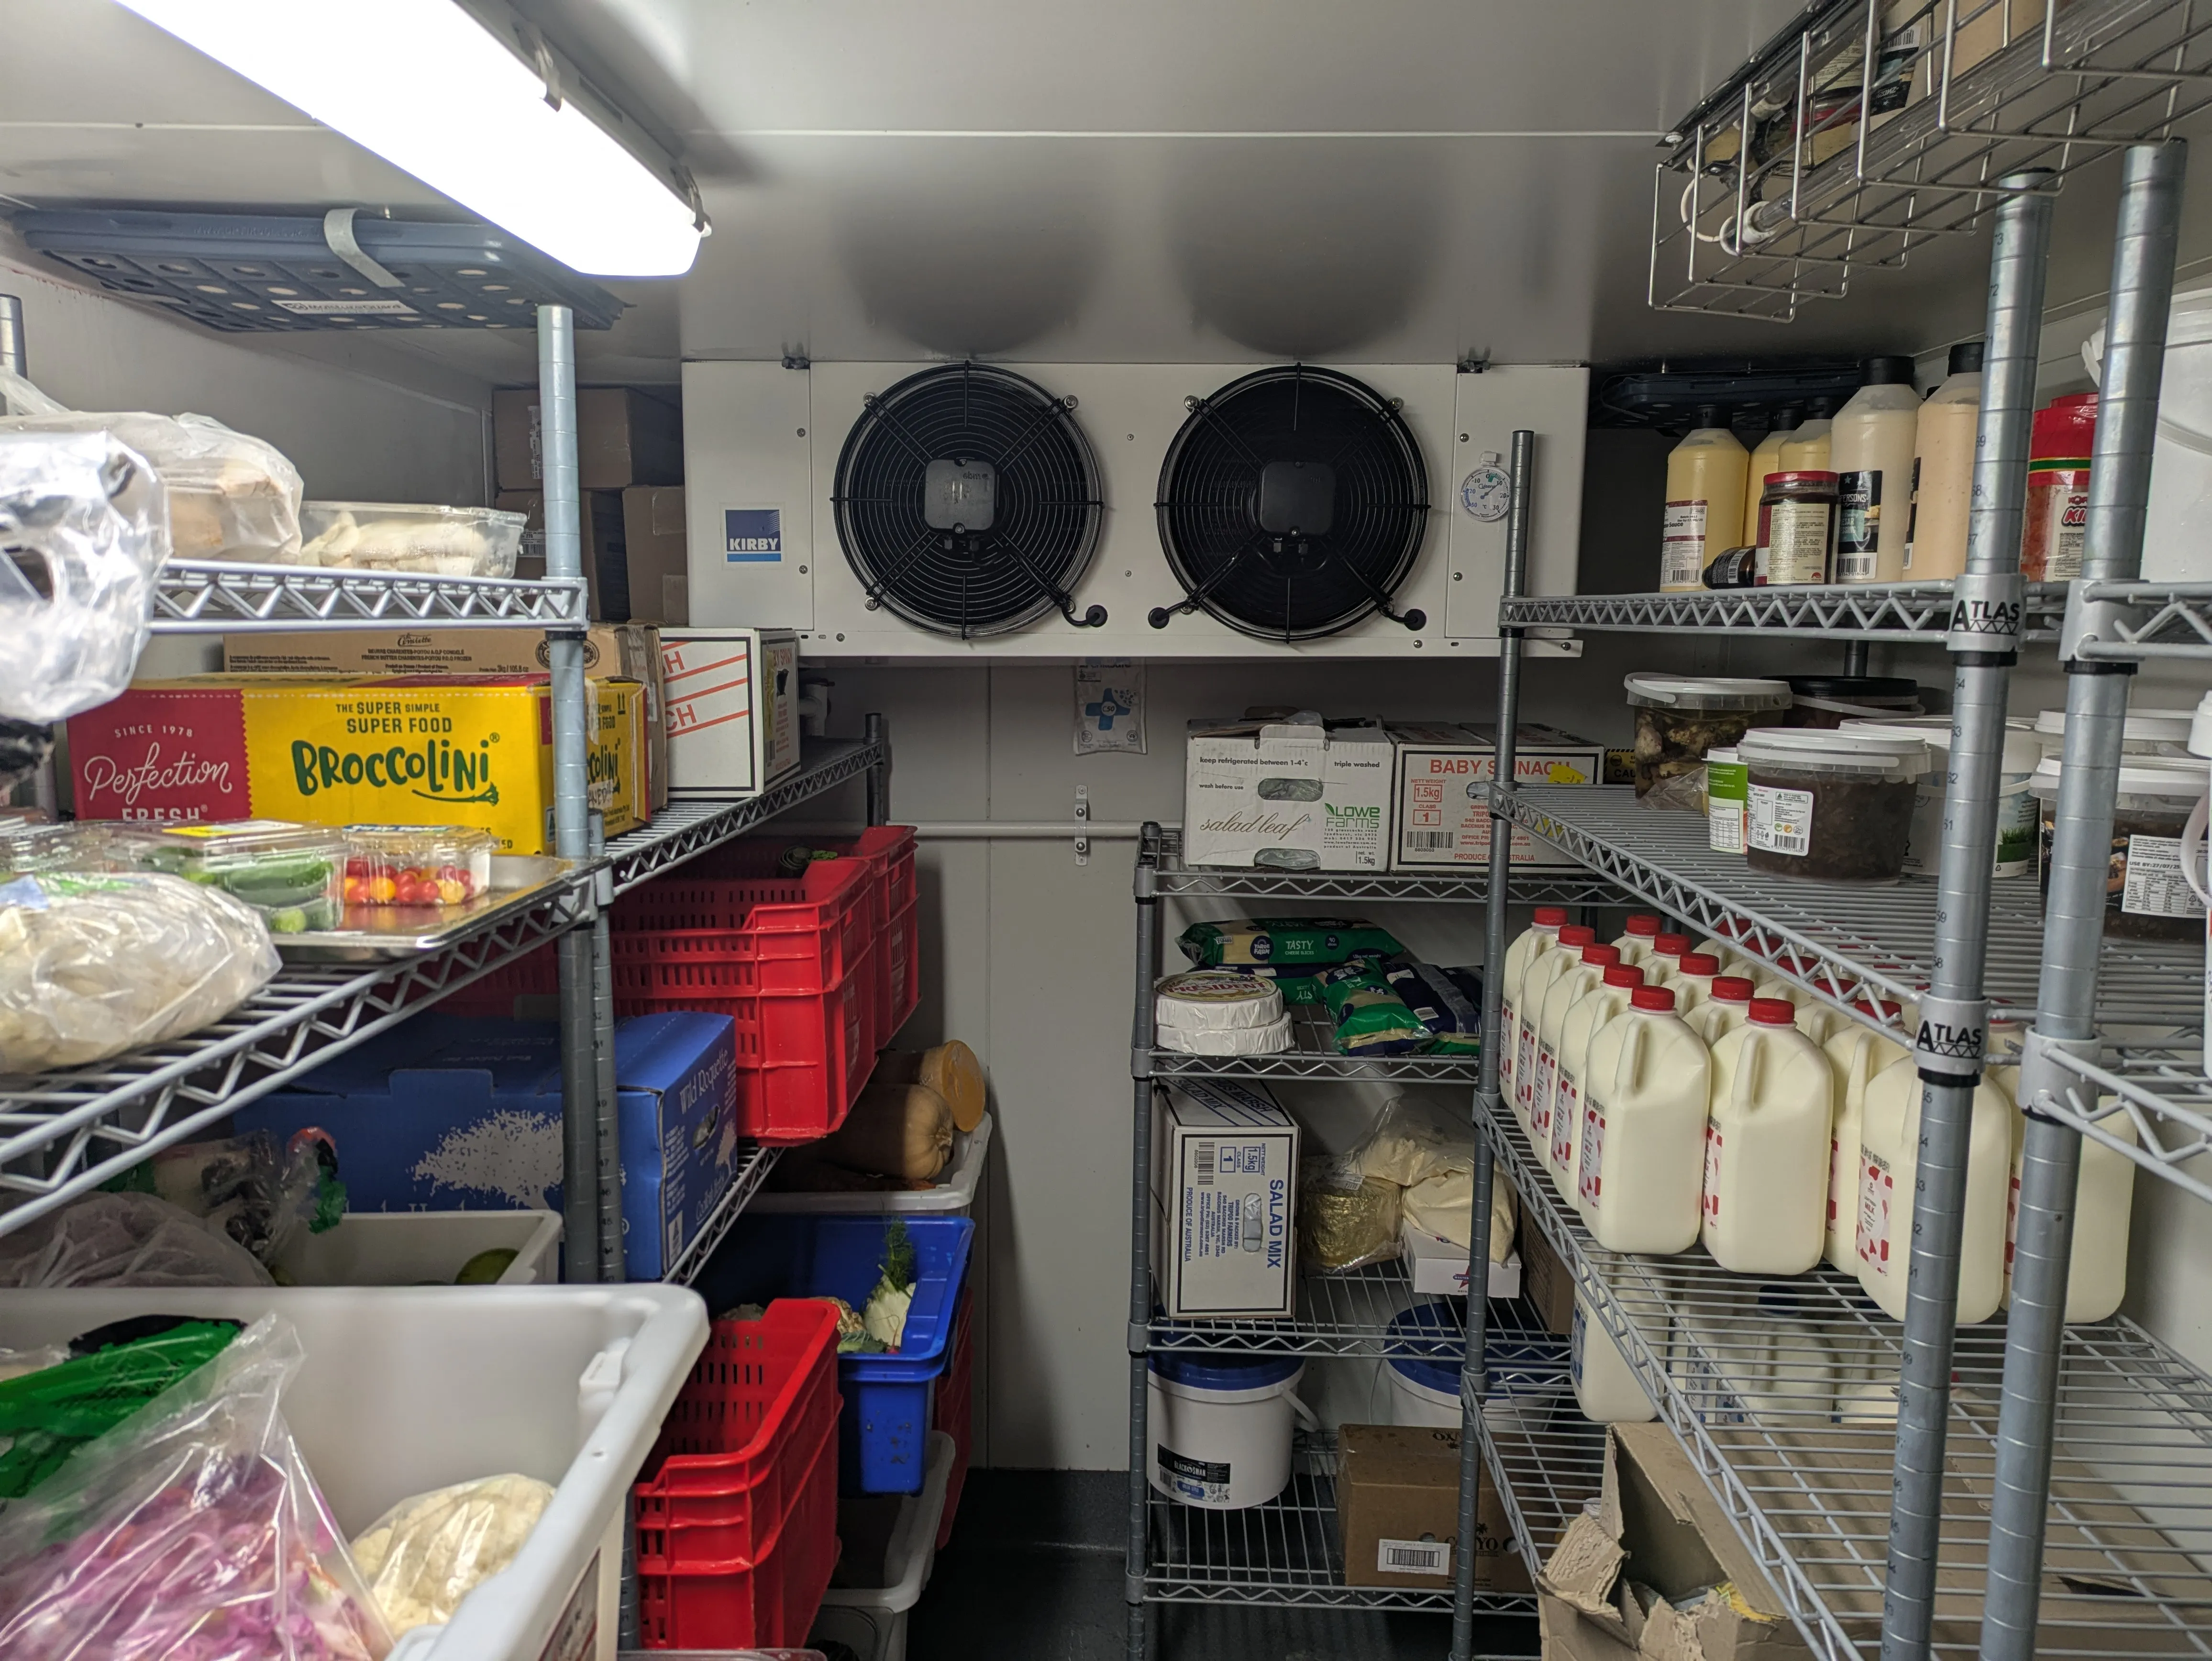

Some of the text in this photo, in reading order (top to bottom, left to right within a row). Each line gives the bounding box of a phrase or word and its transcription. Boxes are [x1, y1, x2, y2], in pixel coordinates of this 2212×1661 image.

[730, 538, 778, 550] KIRBY
[1952, 600, 2020, 631] ATLAS
[336, 701, 440, 714] THE SUPER SIMPLE
[115, 724, 192, 738] SINCE 1978
[346, 717, 452, 733] SUPER FOOD
[84, 742, 233, 805] Perfection
[1430, 759, 1482, 775] BABY
[1416, 786, 1440, 800] 1.5kg
[1423, 813, 1429, 822] 1
[1200, 811, 1310, 841] salad leaf
[1358, 856, 1375, 866] 1.5kg
[1285, 940, 1314, 950] TASTY
[1916, 1021, 1981, 1052] ATLAS
[1201, 1097, 1227, 1108] MIX
[1231, 1091, 1273, 1113] MARSH
[1245, 1148, 1257, 1171] 1.5kg
[1185, 1218, 1193, 1227] OF
[1267, 1179, 1284, 1268] SALAD MIX
[1174, 1460, 1187, 1472] BLACK
[1193, 1466, 1206, 1477] SWAN
